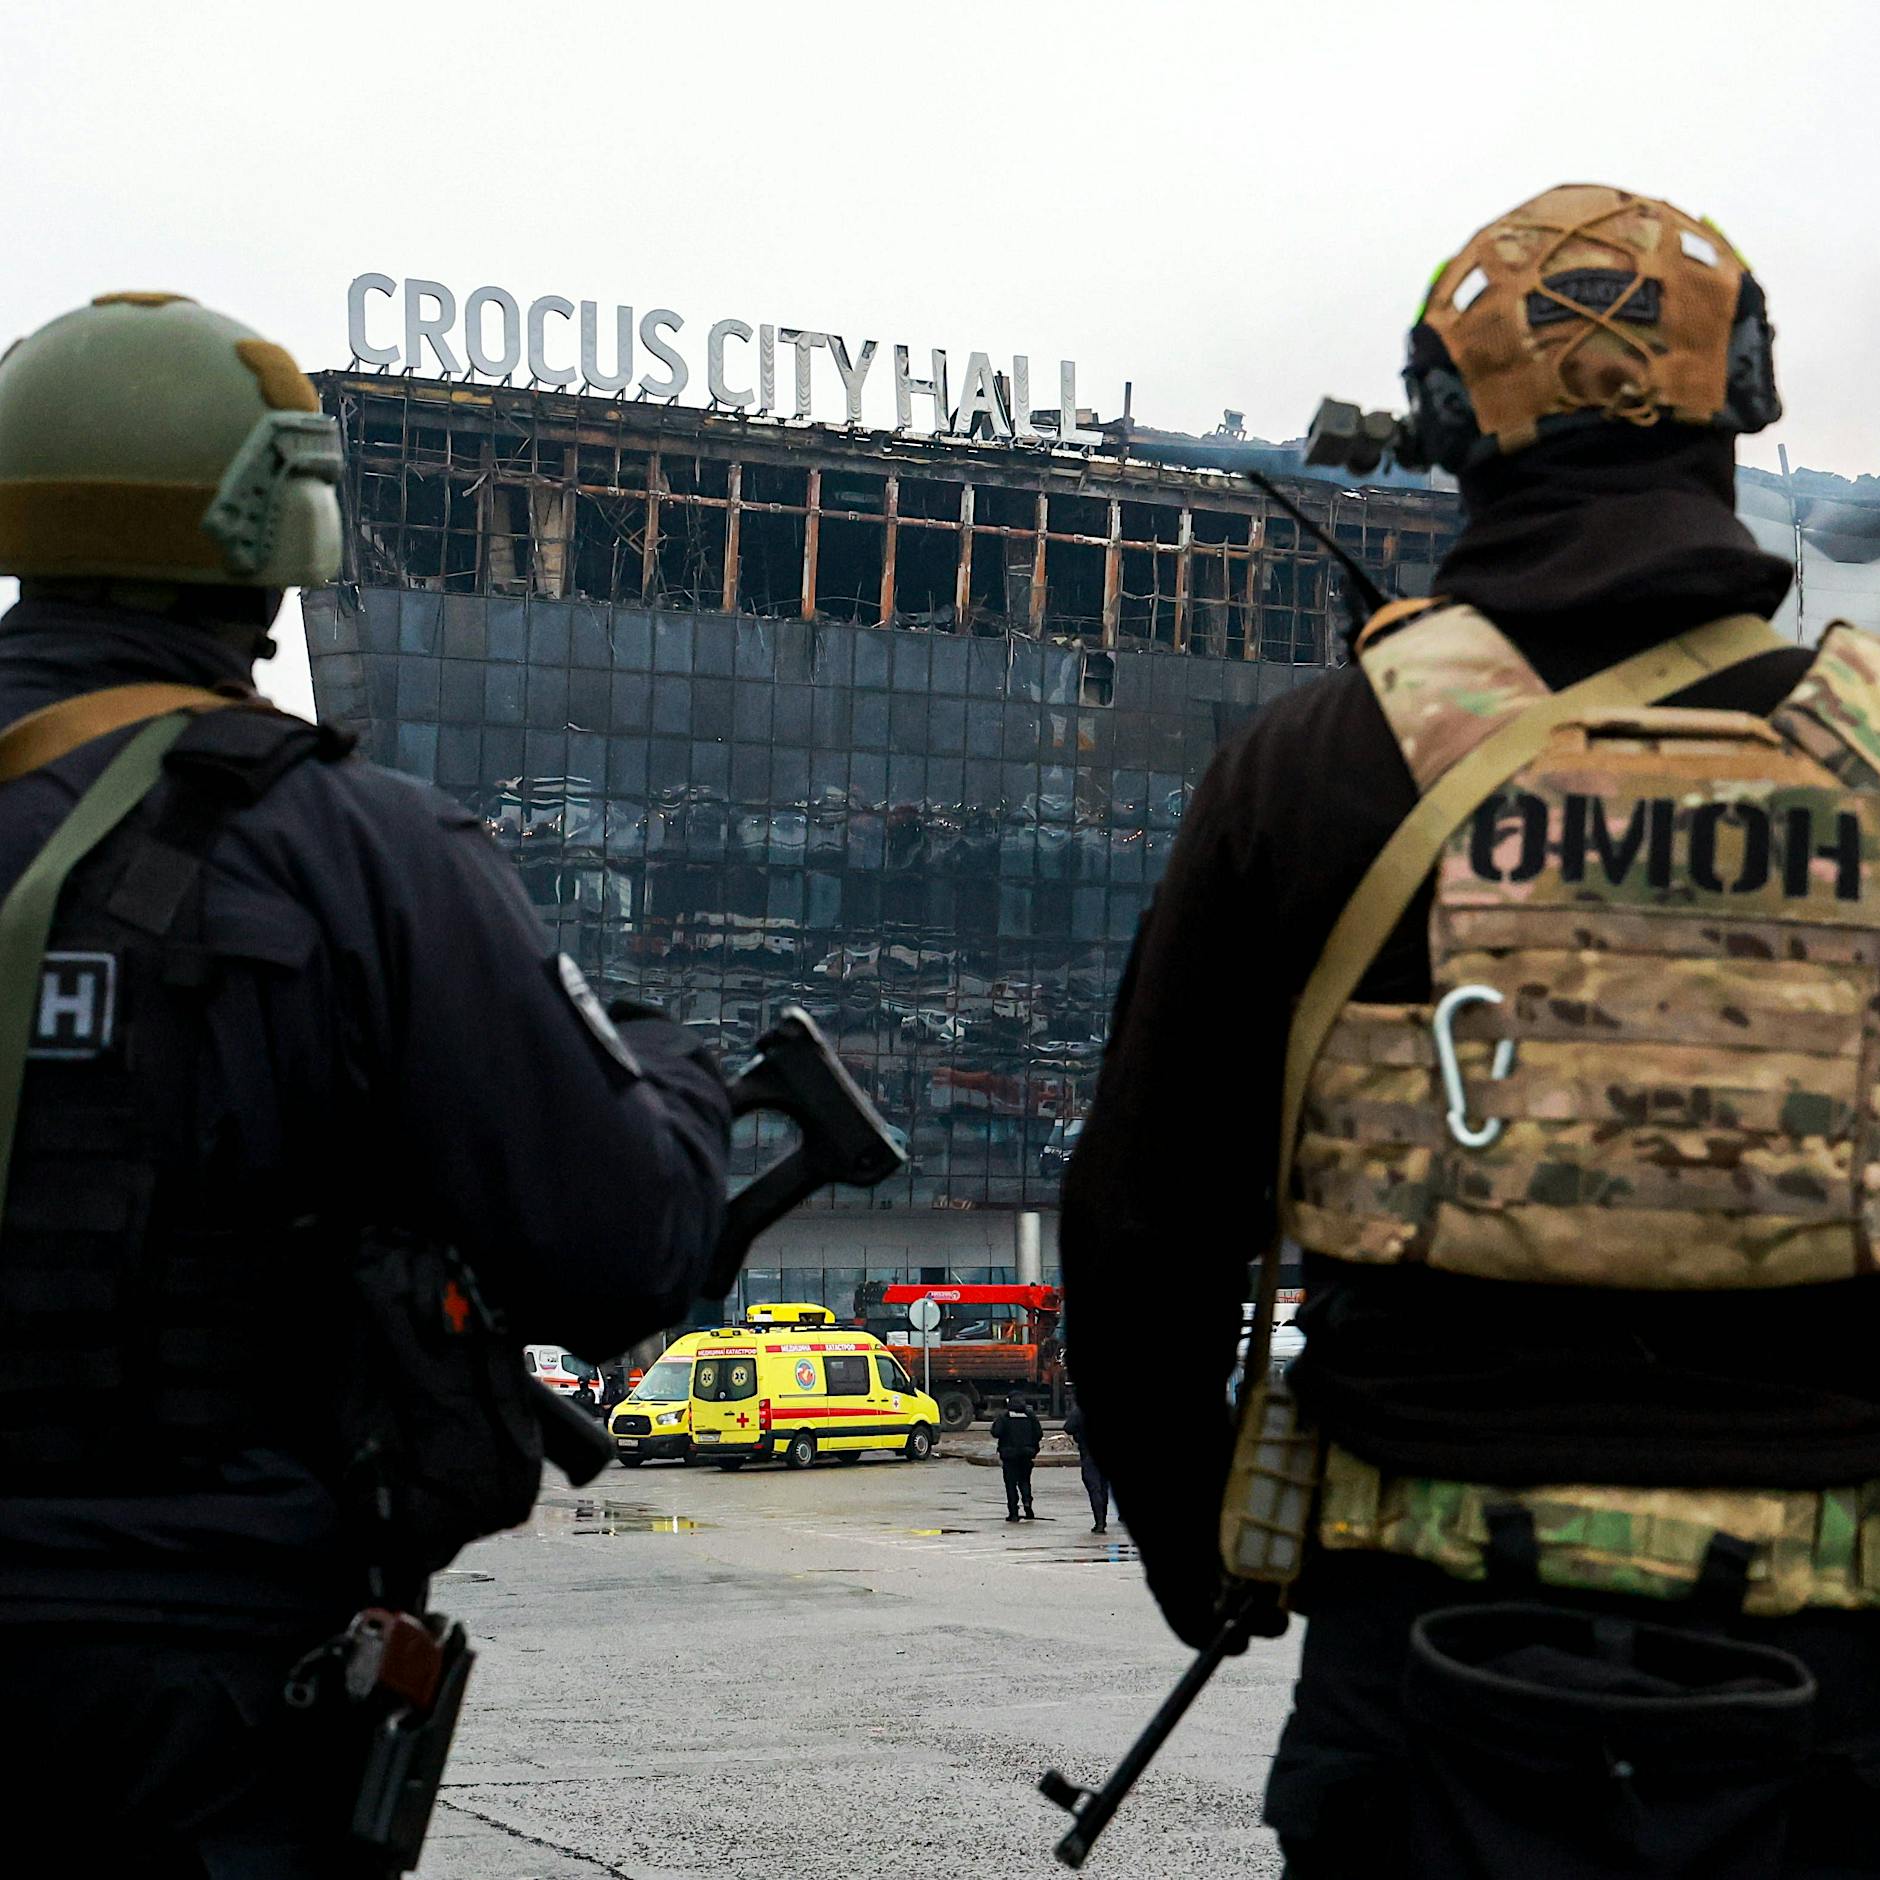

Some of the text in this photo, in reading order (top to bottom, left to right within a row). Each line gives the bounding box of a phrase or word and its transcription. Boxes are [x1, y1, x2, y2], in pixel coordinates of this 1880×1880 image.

[347, 272, 1104, 446] CROCUS CITY HALL
[1470, 793, 1861, 901] ОМОН
